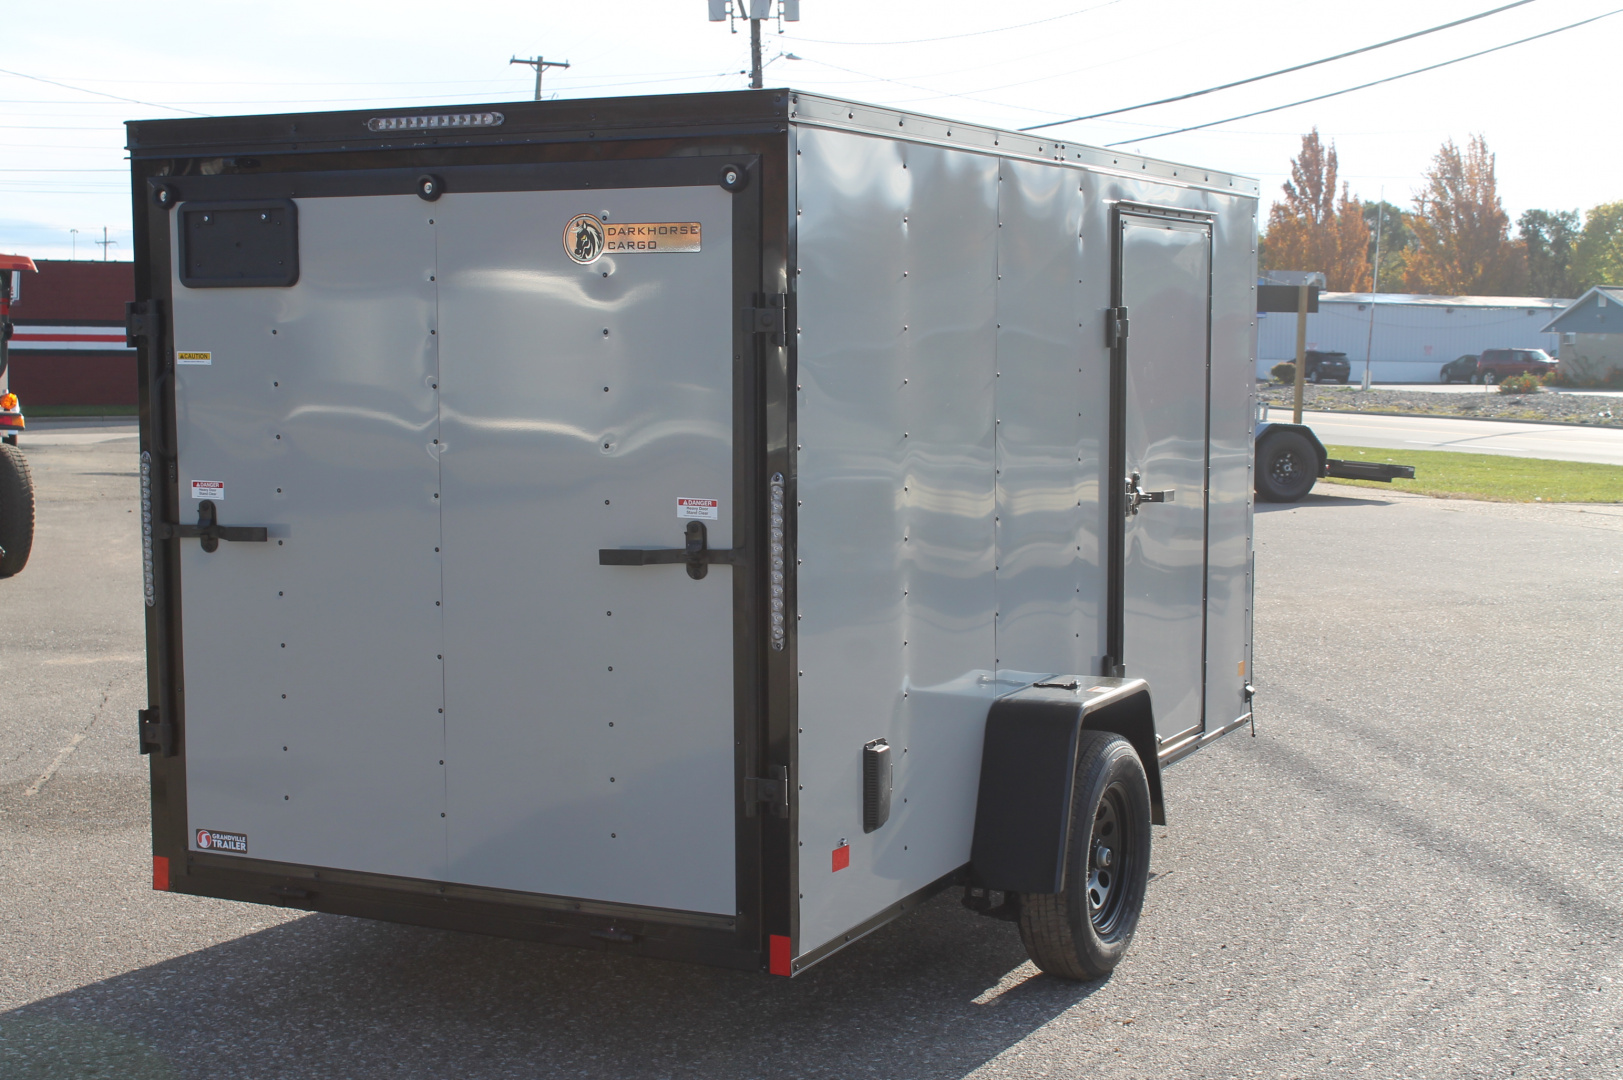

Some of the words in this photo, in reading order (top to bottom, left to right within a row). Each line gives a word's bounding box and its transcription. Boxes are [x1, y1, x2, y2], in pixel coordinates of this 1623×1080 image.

[607, 226, 699, 236] DARKHORSE
[607, 240, 657, 250] CARGO
[212, 834, 246, 842] GRANDVILLE
[212, 840, 247, 851] TRAILER
